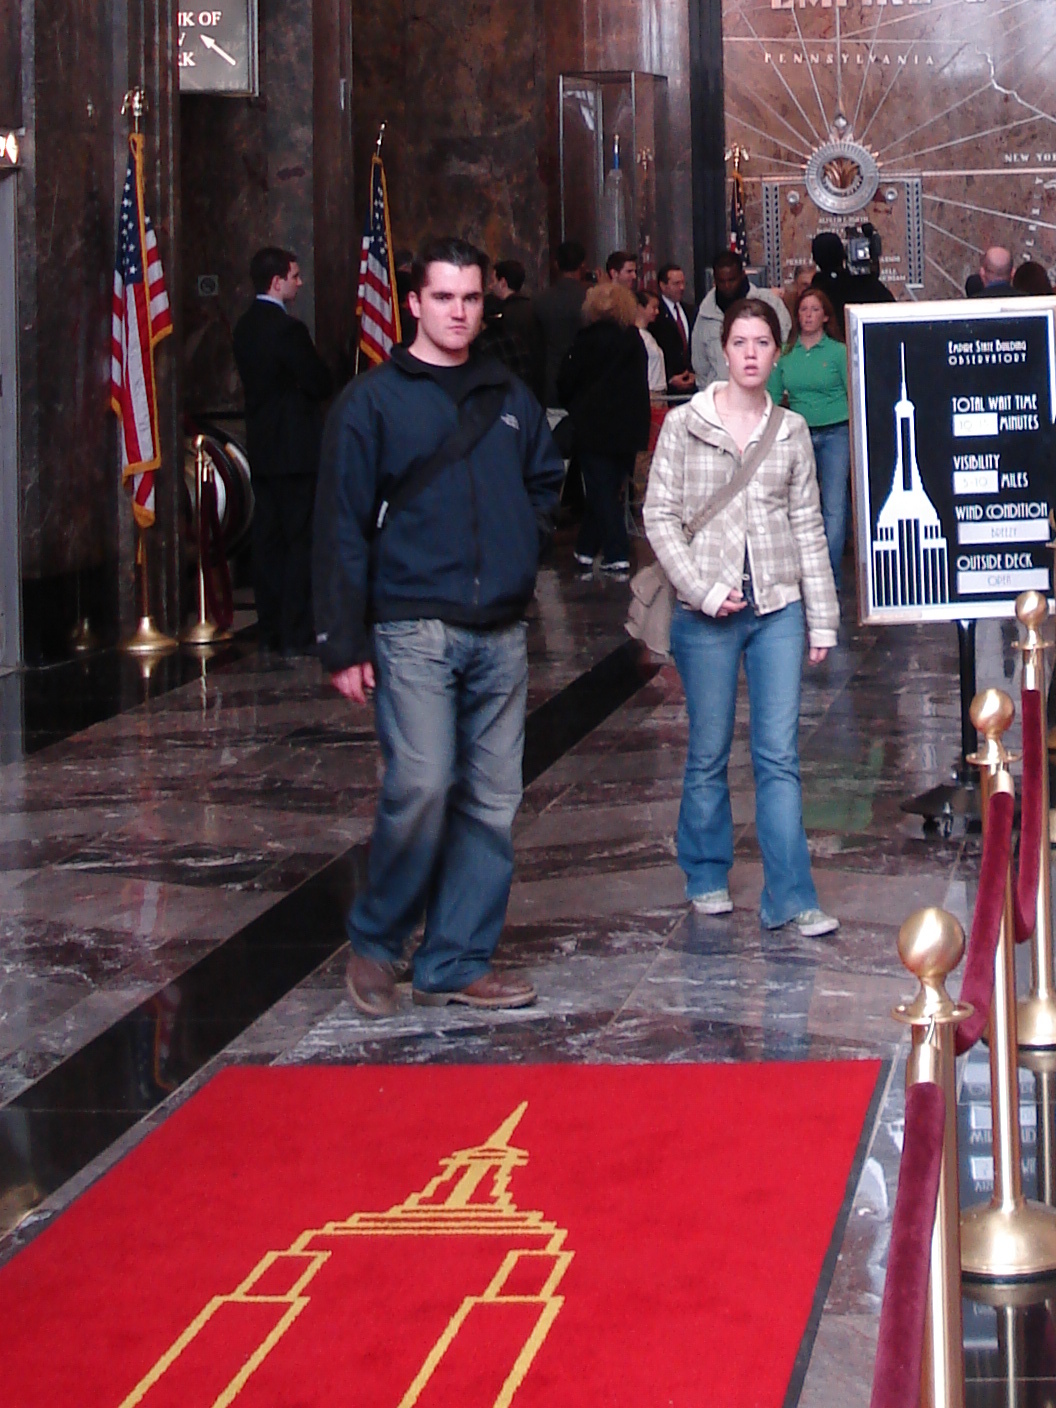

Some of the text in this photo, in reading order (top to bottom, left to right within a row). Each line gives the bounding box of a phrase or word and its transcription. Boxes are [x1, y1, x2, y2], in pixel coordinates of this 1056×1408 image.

[198, 11, 222, 26] OF
[765, 52, 933, 65] PENNSYLVANIA
[1004, 153, 1029, 163] NEW
[948, 339, 1027, 354] EMPIRE STATE BUILDING
[948, 353, 1027, 365] OBSERVATORY
[952, 394, 1037, 412] TOTAL WAIT TIME
[1000, 414, 1039, 430] MINUTES
[953, 454, 1000, 470] VISIBILITY
[1001, 472, 1029, 488] MILES
[955, 502, 1048, 520] WIND CONDITION
[956, 553, 1033, 570] OUTSIDE DECK
